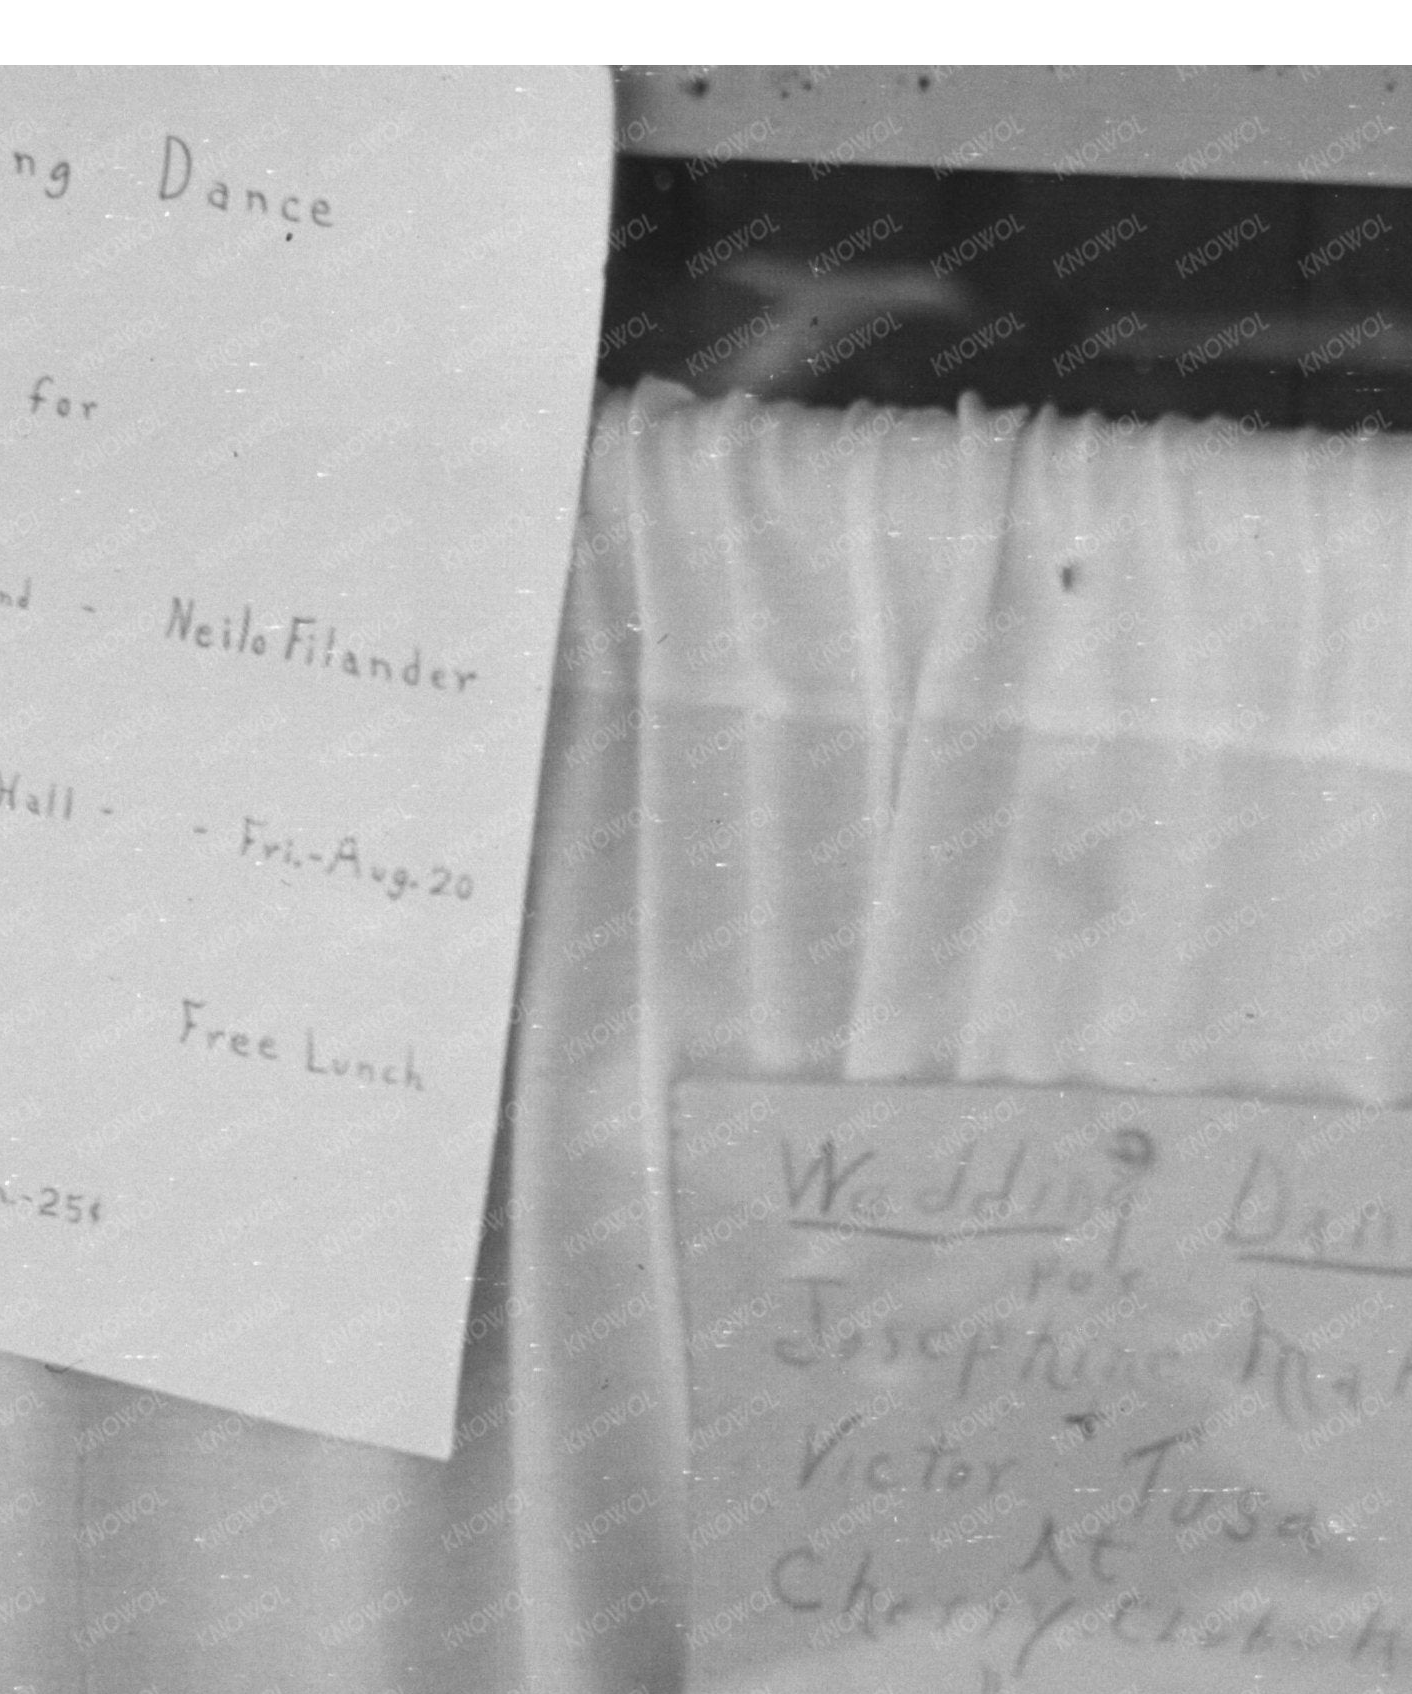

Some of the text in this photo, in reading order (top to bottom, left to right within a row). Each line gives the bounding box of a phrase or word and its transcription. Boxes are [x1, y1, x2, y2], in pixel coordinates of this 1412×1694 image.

[158, 134, 334, 228] Dance
[28, 373, 97, 421] for
[180, 998, 425, 1092] Free Lunch
[796, 1413, 1020, 1491] Victor
